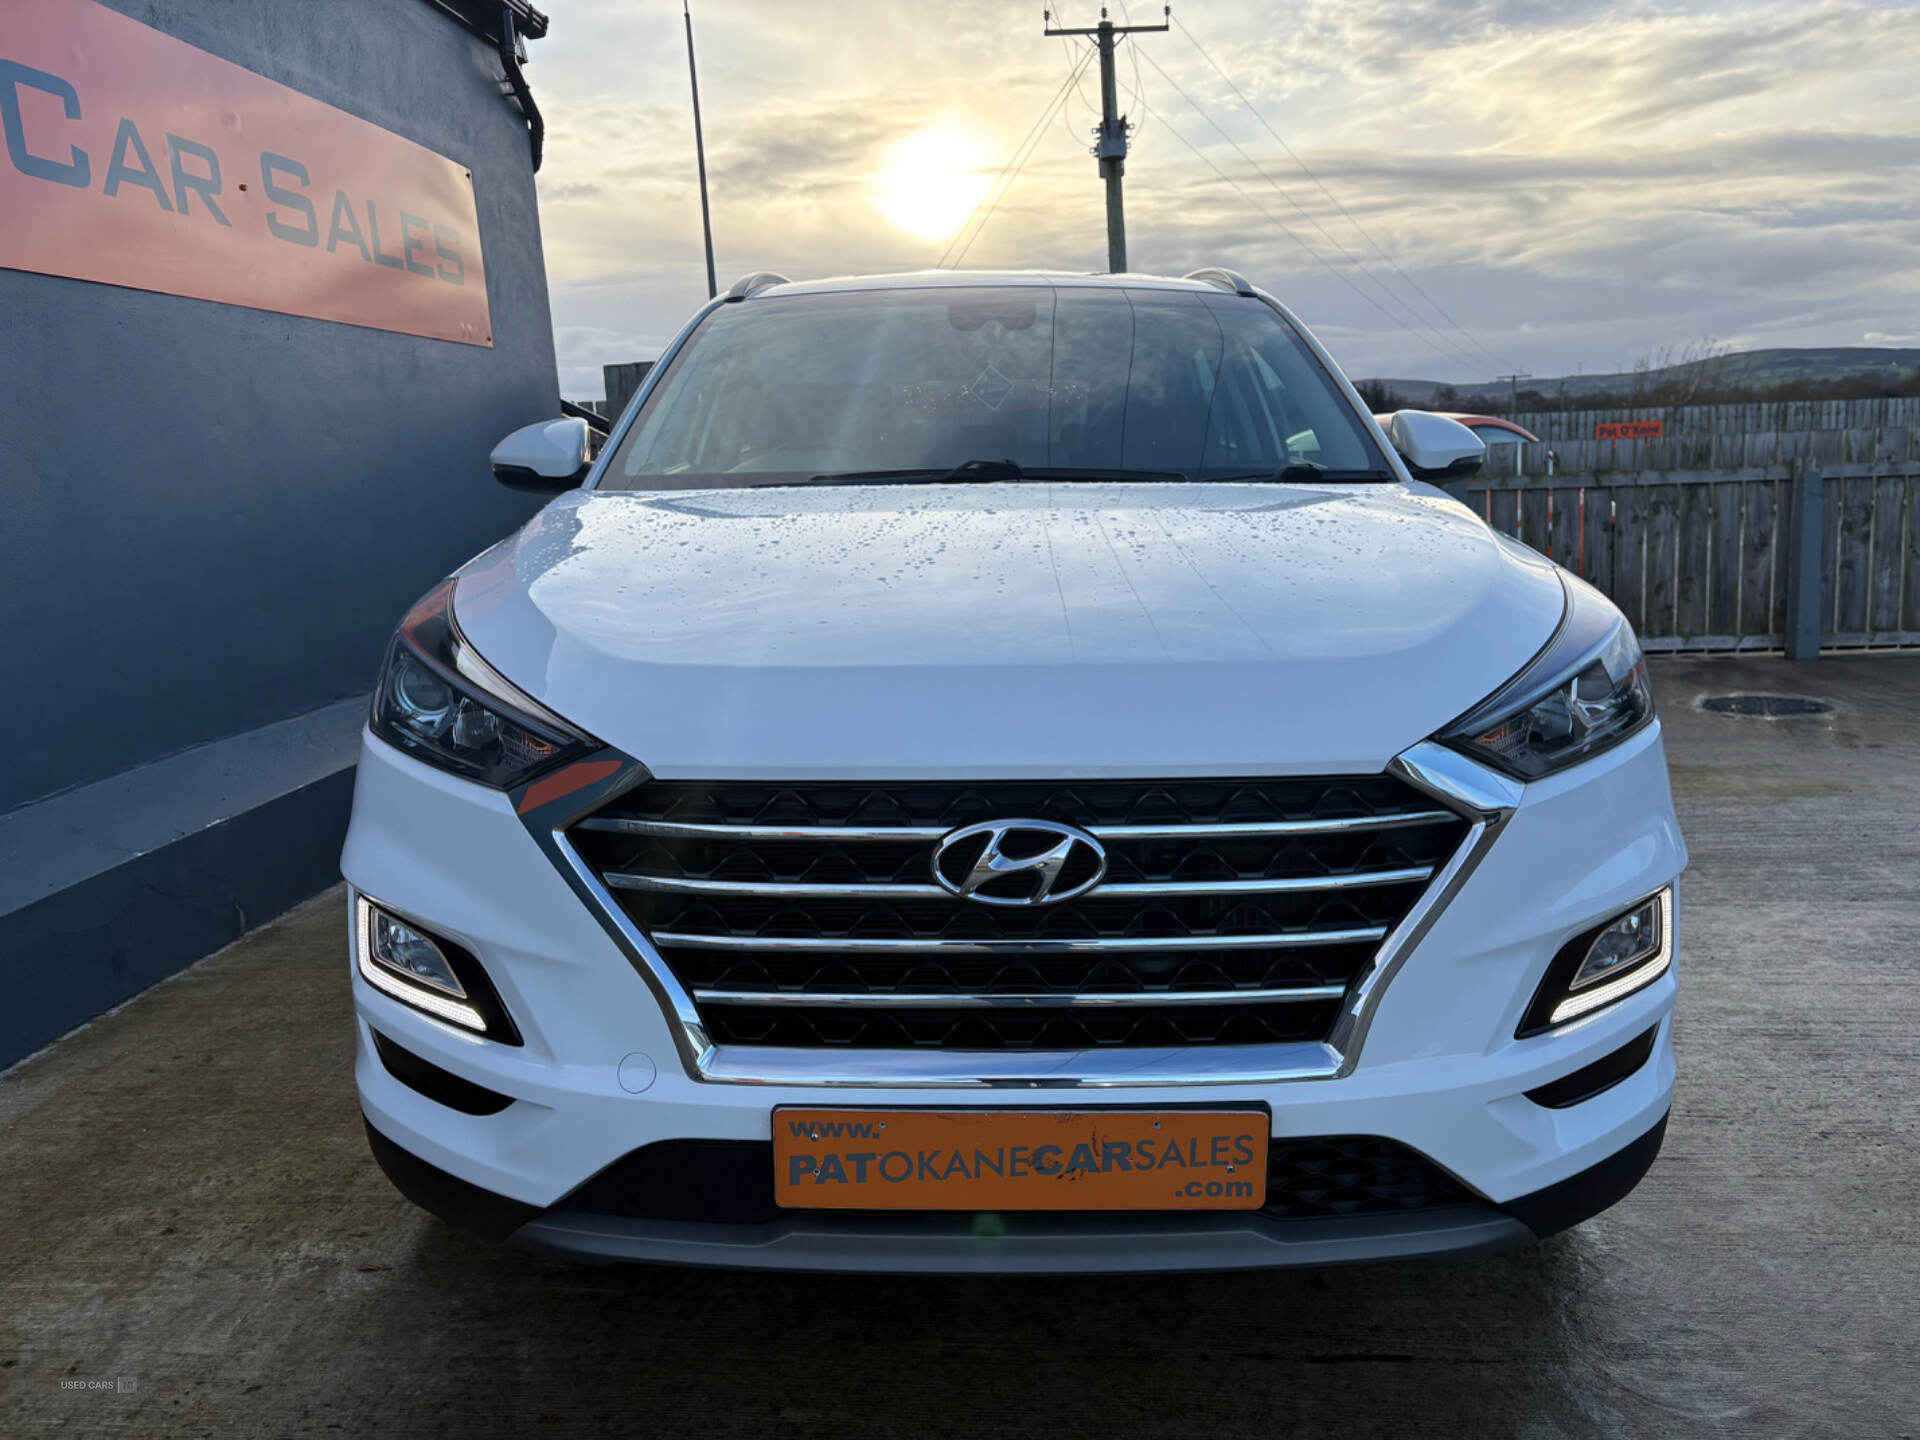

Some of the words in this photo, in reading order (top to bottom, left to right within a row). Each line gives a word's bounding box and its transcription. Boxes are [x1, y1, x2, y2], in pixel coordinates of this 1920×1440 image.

[0, 58, 232, 227] CAR
[260, 151, 465, 286] SALES
[788, 1121, 880, 1140] www.
[789, 1134, 1254, 1186] PATOKANECARSALES
[1175, 1180, 1253, 1198] .com
